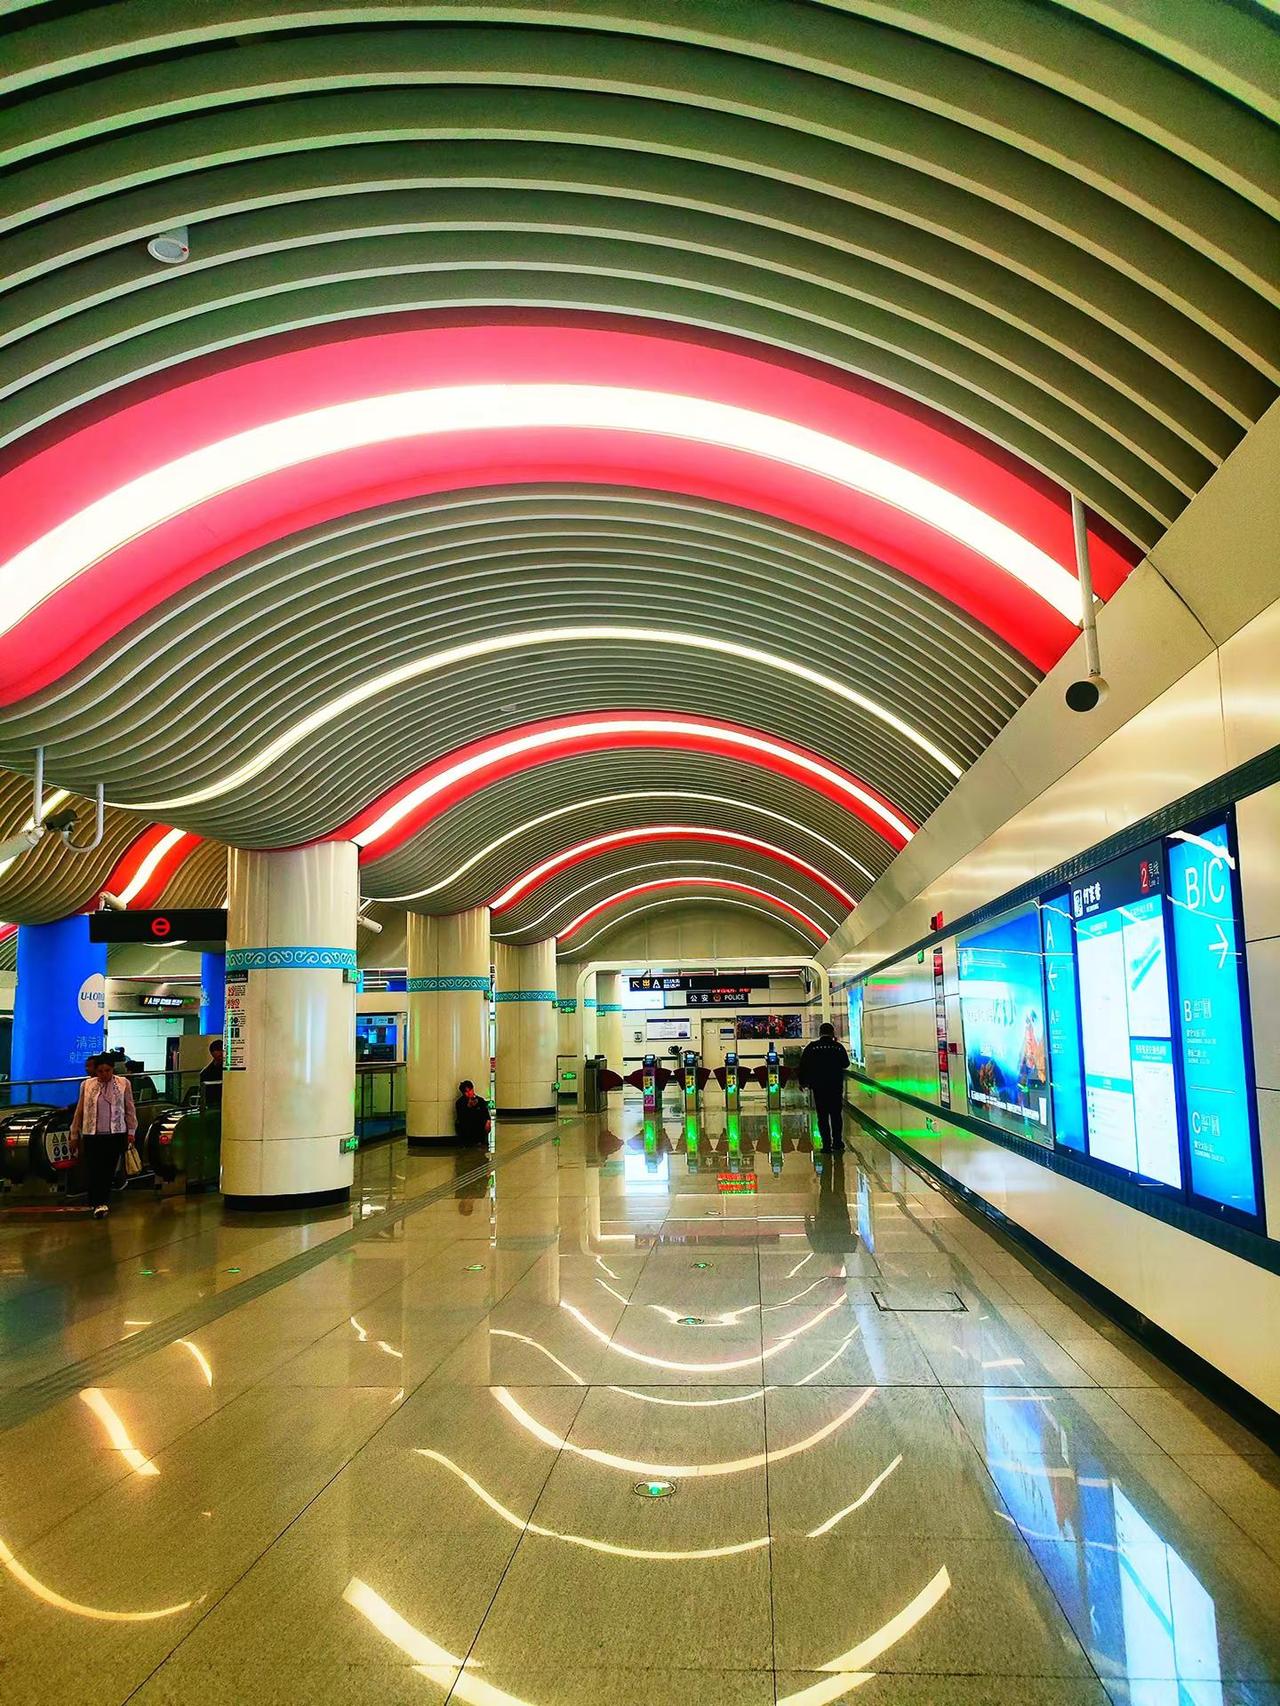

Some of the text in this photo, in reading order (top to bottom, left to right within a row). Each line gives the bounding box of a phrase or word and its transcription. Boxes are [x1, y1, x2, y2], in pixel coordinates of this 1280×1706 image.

[1141, 868, 1148, 888] 2
[1185, 857, 1225, 910] B/C
[1046, 920, 1055, 949] A
[652, 979, 661, 989] A
[690, 994, 709, 1002] 公安
[1183, 999, 1192, 1022] B
[76, 1036, 102, 1049] 清洁
[1192, 1111, 1201, 1134] C
